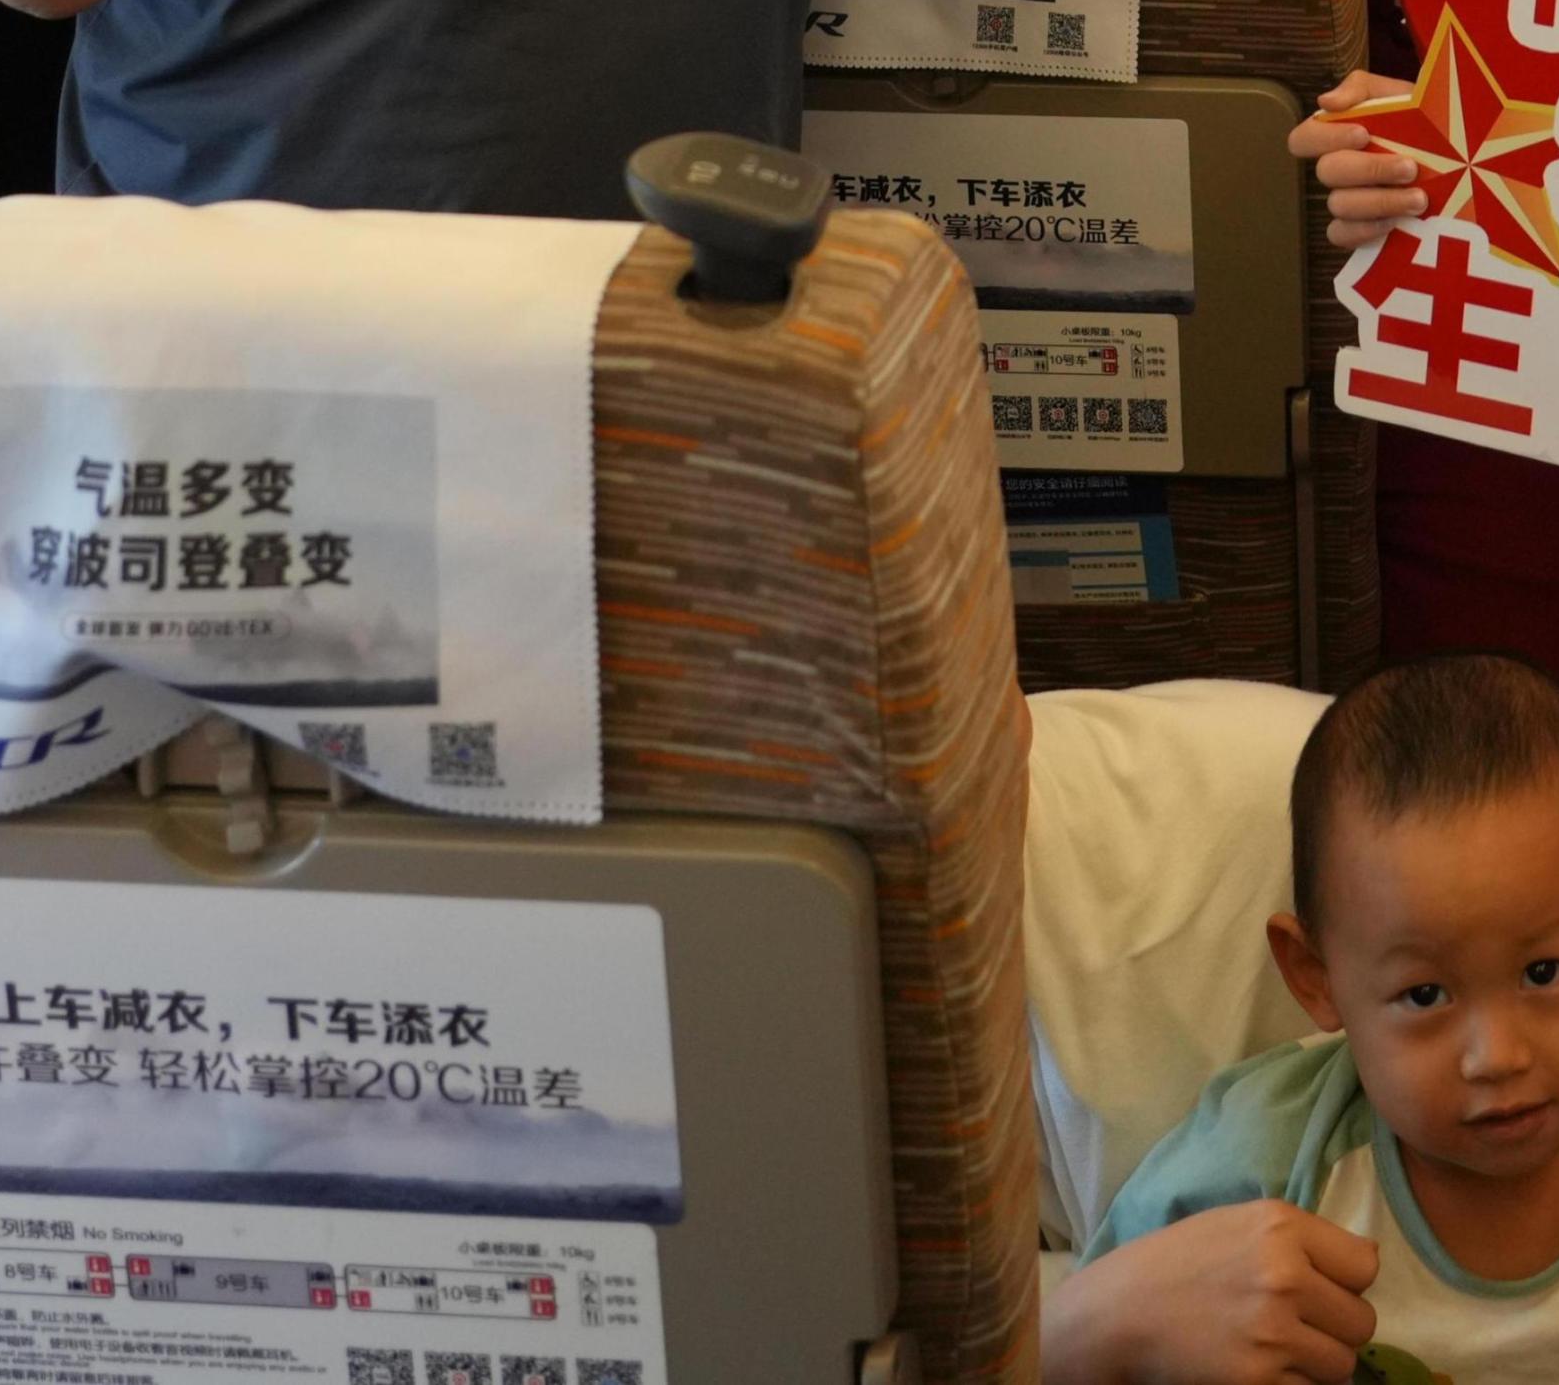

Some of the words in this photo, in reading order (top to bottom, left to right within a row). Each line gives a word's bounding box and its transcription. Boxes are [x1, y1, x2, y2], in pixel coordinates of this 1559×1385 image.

[75, 454, 298, 521] 气温多变
[28, 525, 354, 594] 穿波司登叠变
[137, 1044, 585, 1111] 轻松掌控20℃温差
[83, 1227, 108, 1242] No
[112, 1229, 184, 1247] Smoking
[4, 1262, 58, 1282] 8号车
[215, 1272, 270, 1293] 9号车
[441, 1285, 506, 1305] 10号车
